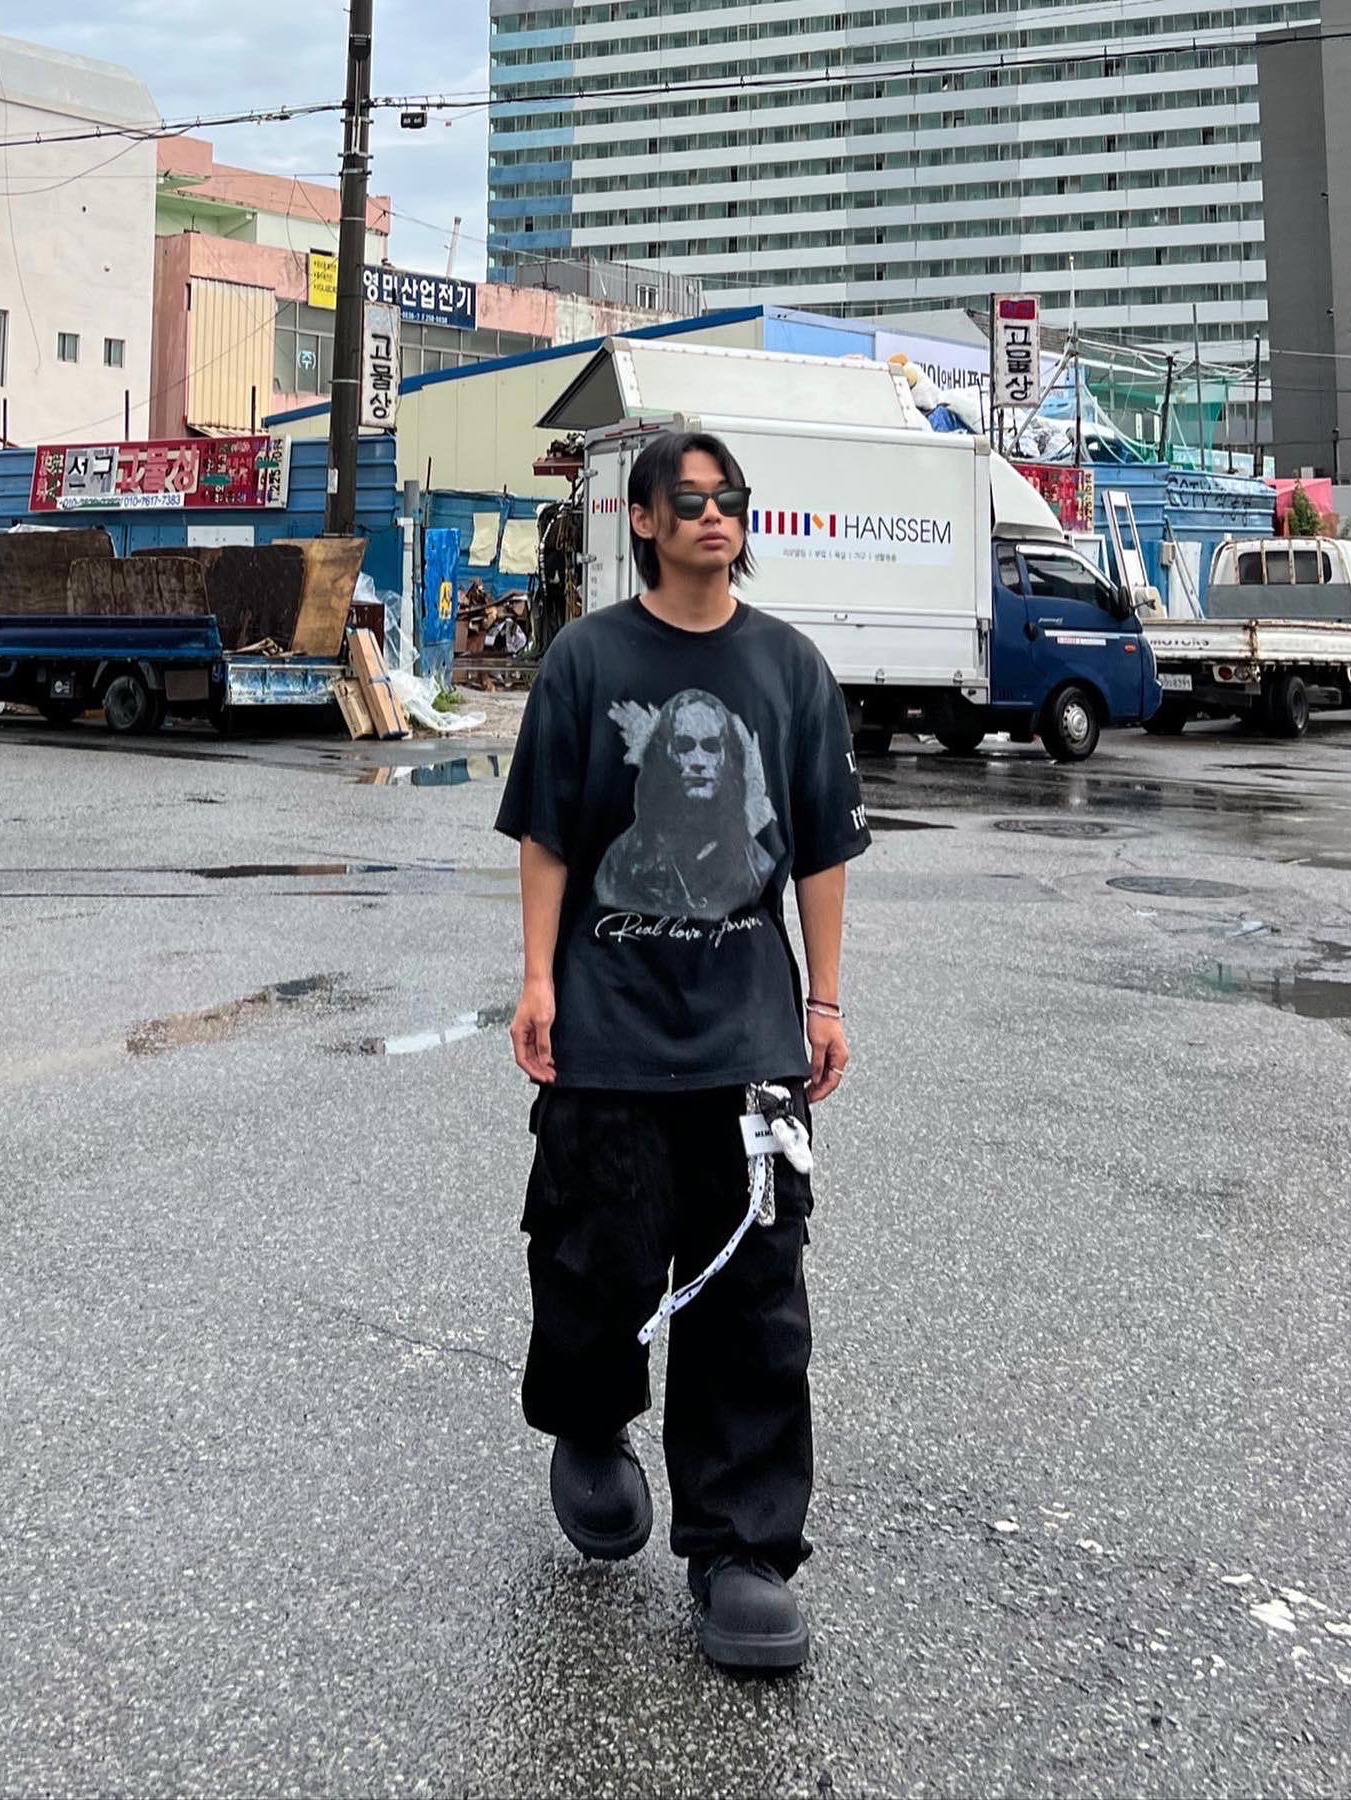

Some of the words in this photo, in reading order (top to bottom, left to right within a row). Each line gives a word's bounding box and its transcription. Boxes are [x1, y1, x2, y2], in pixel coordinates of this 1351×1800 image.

[844, 515, 951, 544] HANSSEM
[595, 912, 669, 942] Real
[668, 915, 703, 942] love
